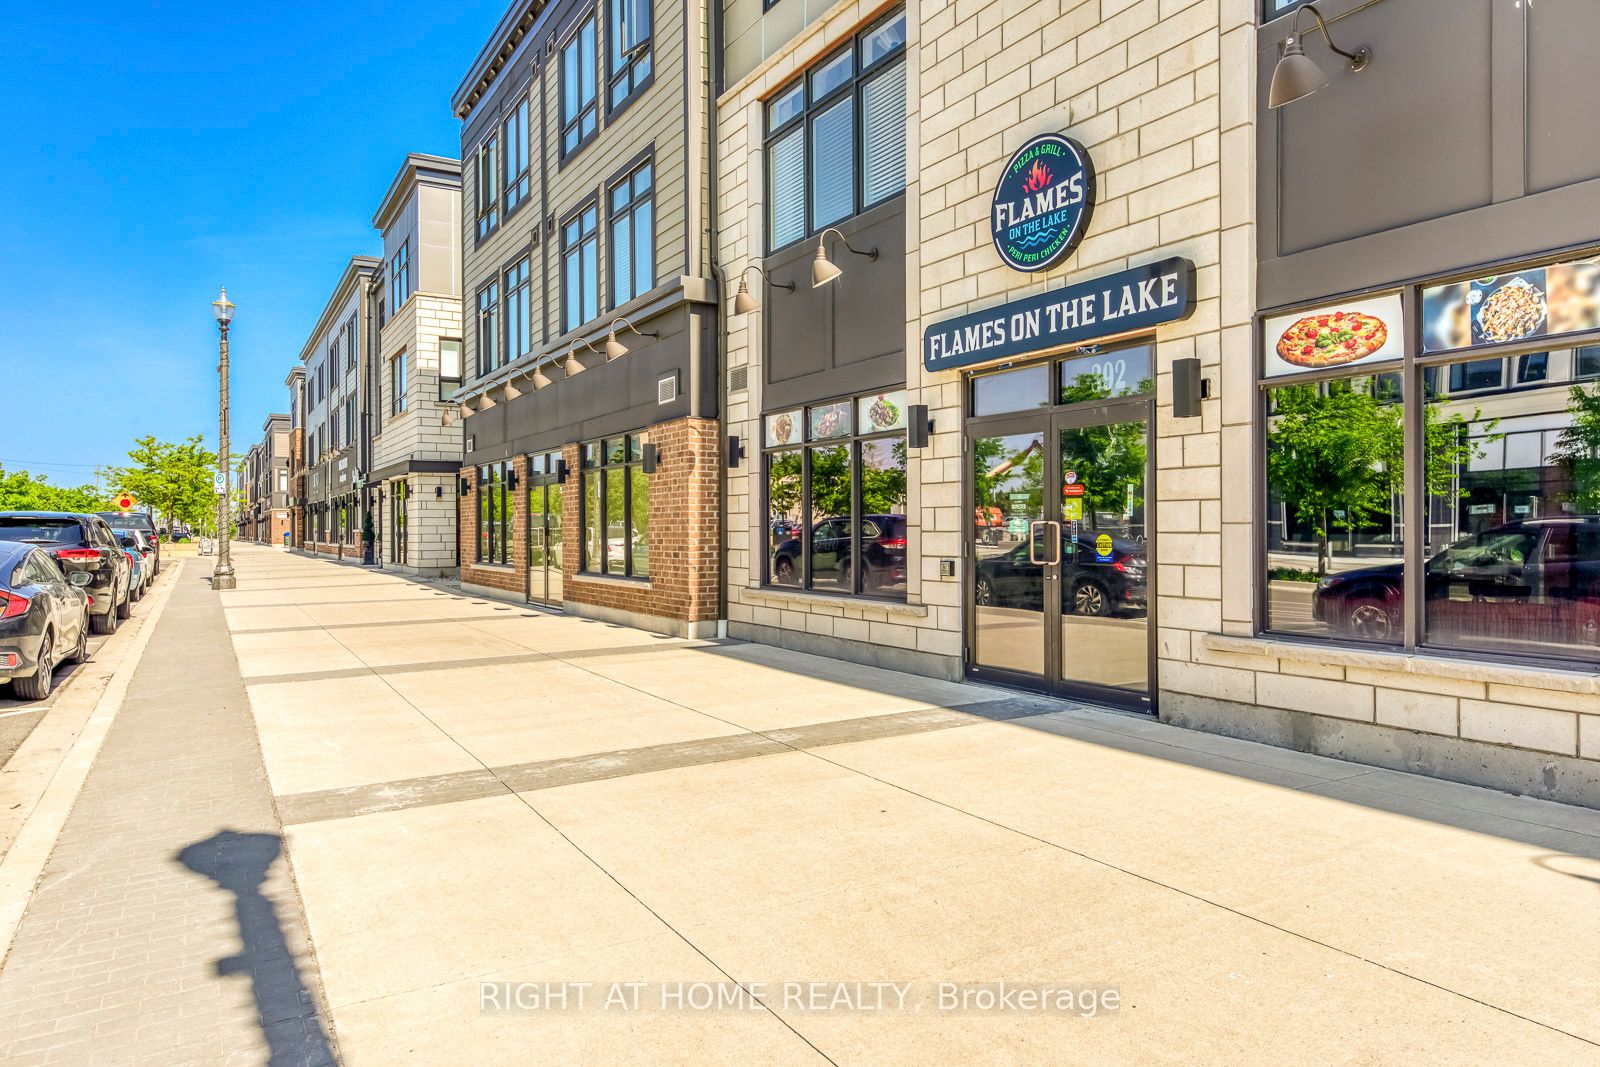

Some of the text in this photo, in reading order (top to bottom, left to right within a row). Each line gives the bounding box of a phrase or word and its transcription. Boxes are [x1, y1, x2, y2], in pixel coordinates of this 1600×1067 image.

[1013, 144, 1062, 174] PIZZA & GRILL
[995, 170, 1083, 233] FLAMES
[1009, 209, 1067, 240] ON THE LAKE
[1008, 228, 1069, 262] PERI PERI CHICKEN
[929, 272, 1178, 361] FLAMES ON THE LAKE
